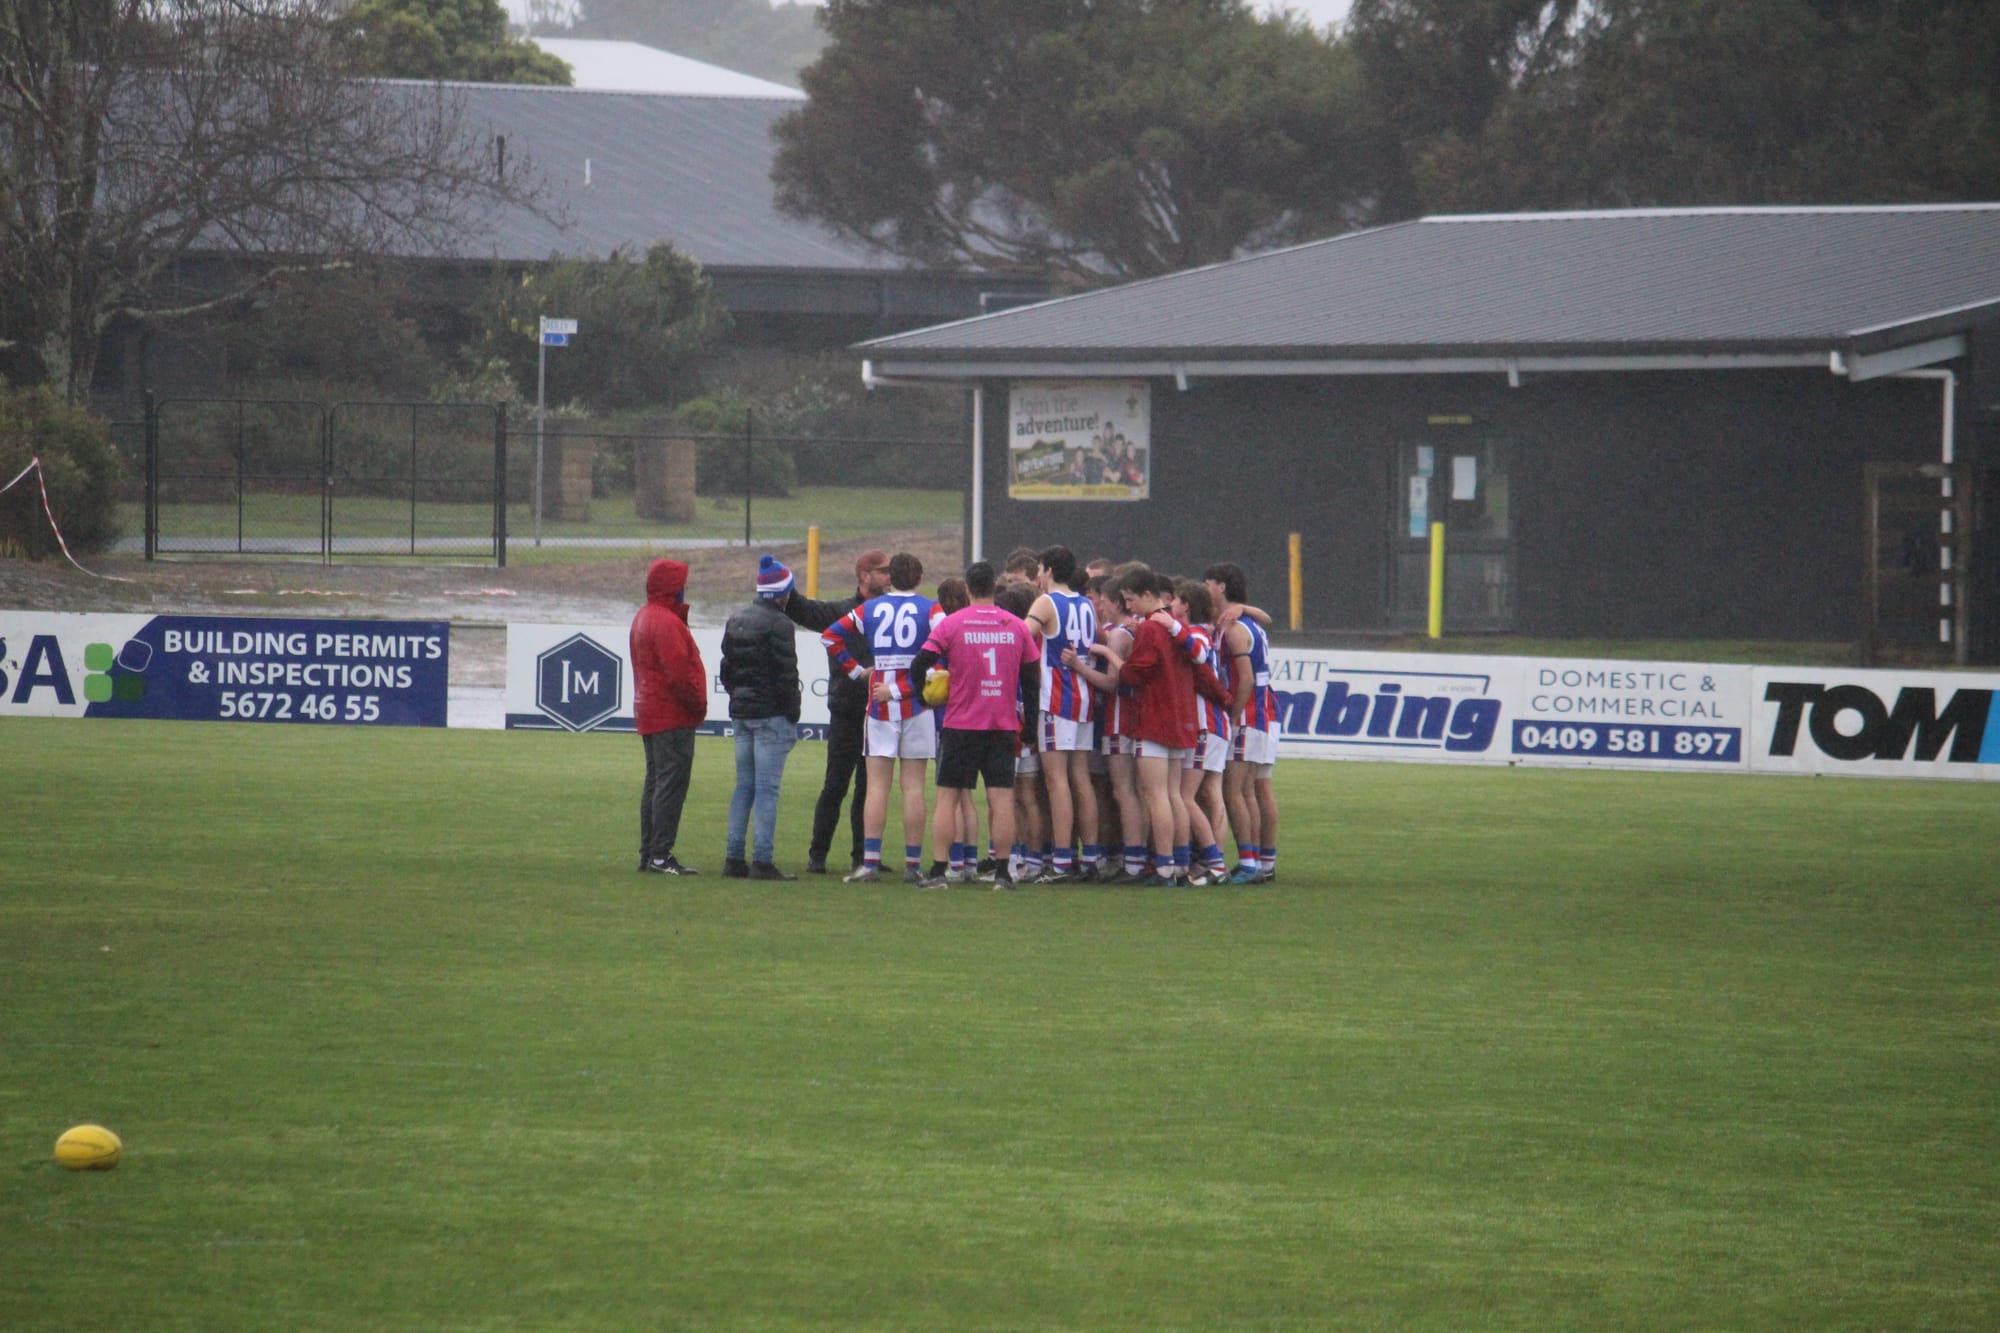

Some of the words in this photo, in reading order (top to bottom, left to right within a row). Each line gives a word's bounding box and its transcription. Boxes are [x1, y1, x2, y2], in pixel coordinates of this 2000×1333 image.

[1054, 393, 1079, 412] the
[1016, 413, 1099, 436] adventure!
[873, 602, 918, 648] 26
[964, 632, 1015, 645] RUNNER
[1065, 602, 1096, 649] 40
[165, 630, 307, 657] BUILDING
[316, 634, 442, 659] PERMITS
[0, 635, 76, 704] A
[188, 661, 210, 684] &
[217, 662, 413, 688] INSPECTIONS
[983, 648, 997, 676] 1
[1540, 669, 1687, 692] DOMESTIC
[1701, 675, 1717, 692] &
[220, 691, 292, 719] 5672
[300, 694, 337, 720] 46
[344, 696, 380, 721] 55
[1272, 681, 1502, 752] mbing
[1532, 695, 1724, 719] COMMERCIAL
[1764, 682, 1994, 763] TOM
[1522, 726, 1598, 750] 0409
[1608, 730, 1660, 753] 581
[1674, 732, 1732, 755] 897
